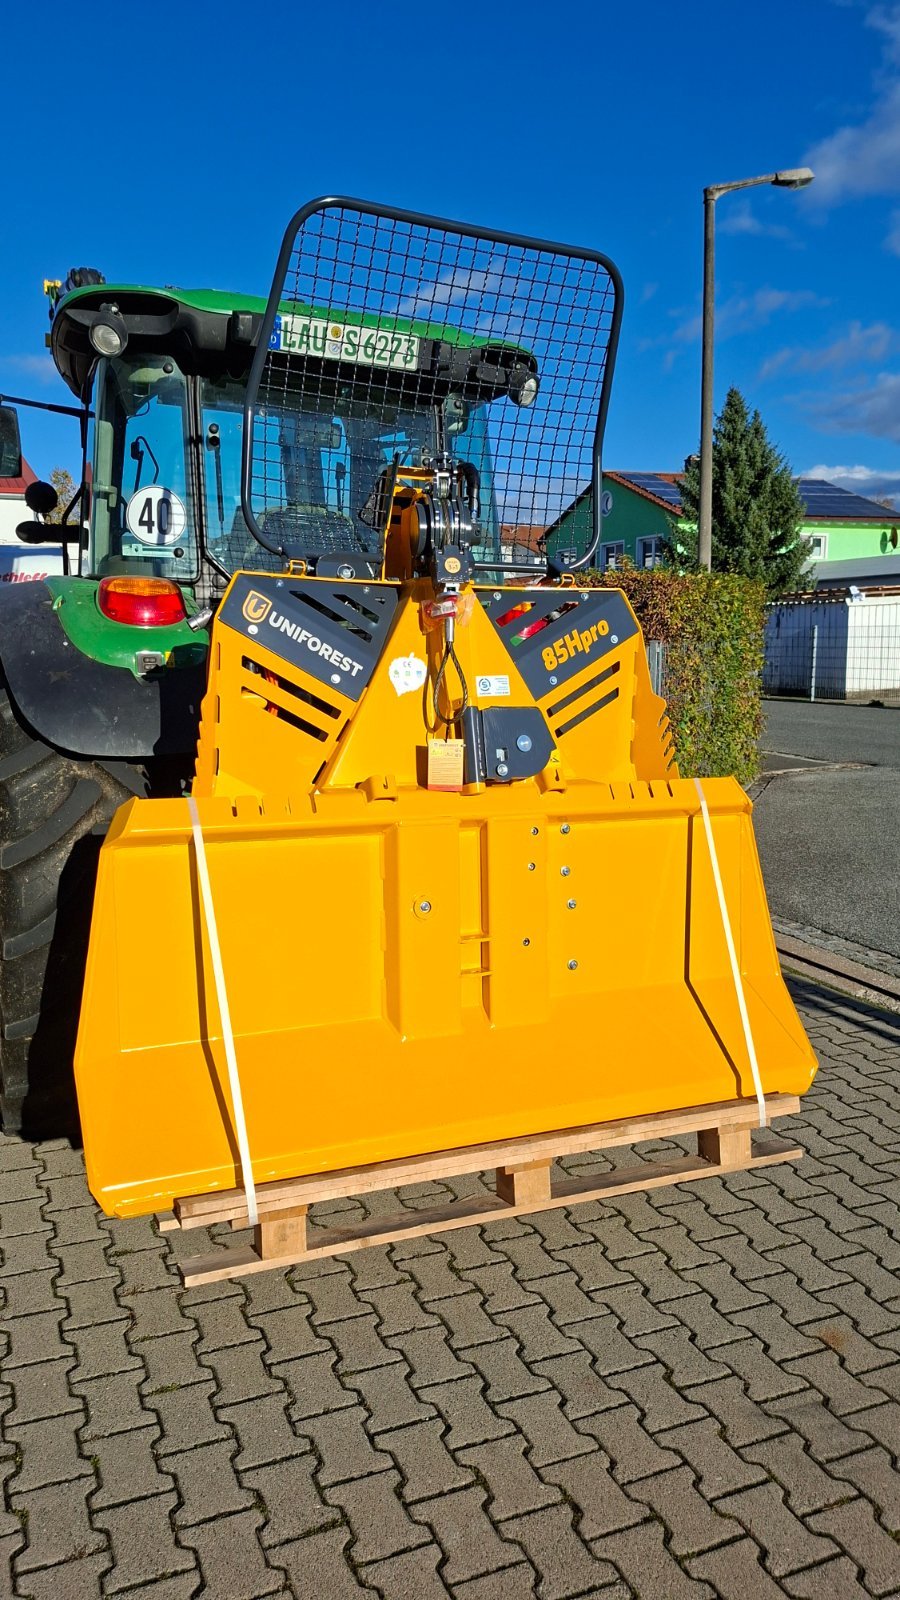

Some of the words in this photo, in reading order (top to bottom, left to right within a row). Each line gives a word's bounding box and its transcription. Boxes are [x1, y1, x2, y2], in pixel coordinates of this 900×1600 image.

[282, 320, 326, 352] LAU
[344, 329, 359, 357] S
[363, 333, 416, 365] 6273
[138, 497, 172, 535] 40
[268, 611, 364, 677] UNIFOREST
[541, 619, 610, 671] 85Hpro
